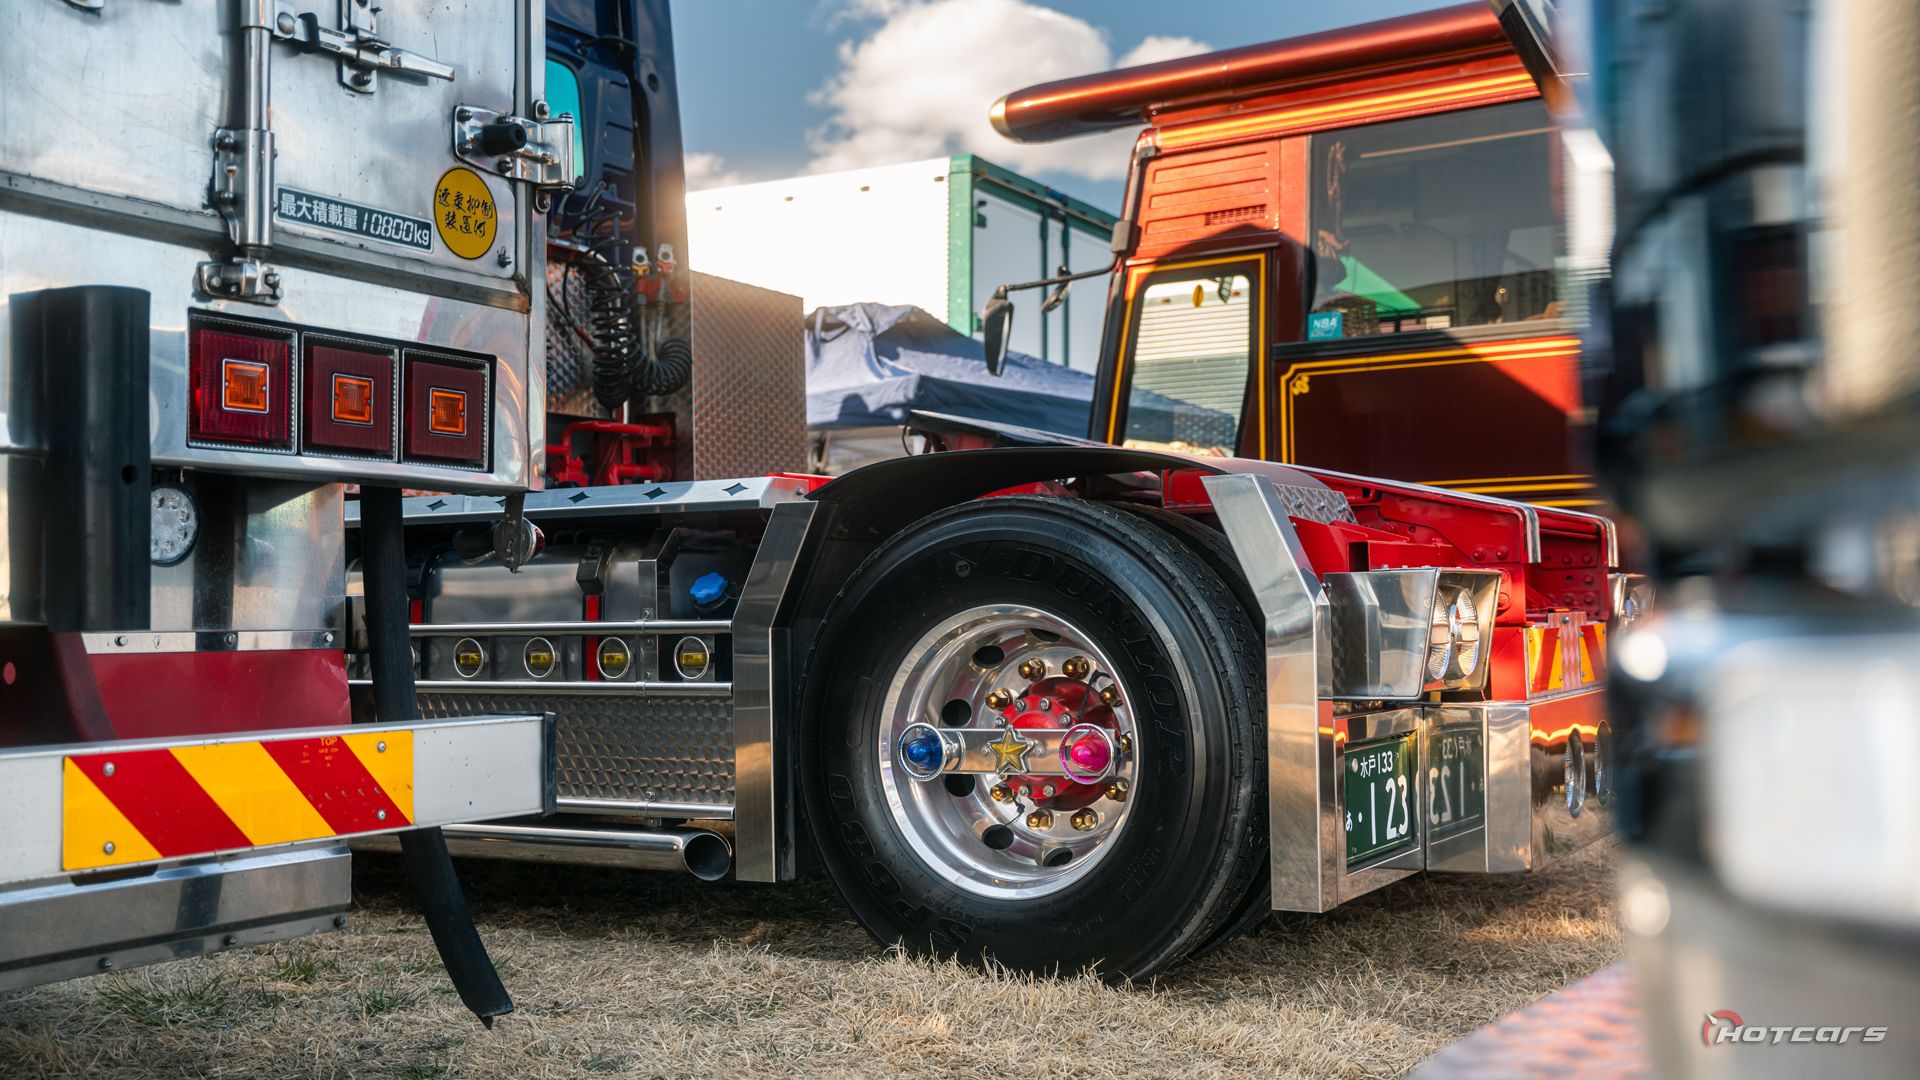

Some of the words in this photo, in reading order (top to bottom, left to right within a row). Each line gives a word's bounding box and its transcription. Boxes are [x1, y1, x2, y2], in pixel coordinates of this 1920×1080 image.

[280, 193, 358, 231] 最大積載量
[362, 211, 430, 246] 10800kg
[320, 736, 338, 746] TOP
